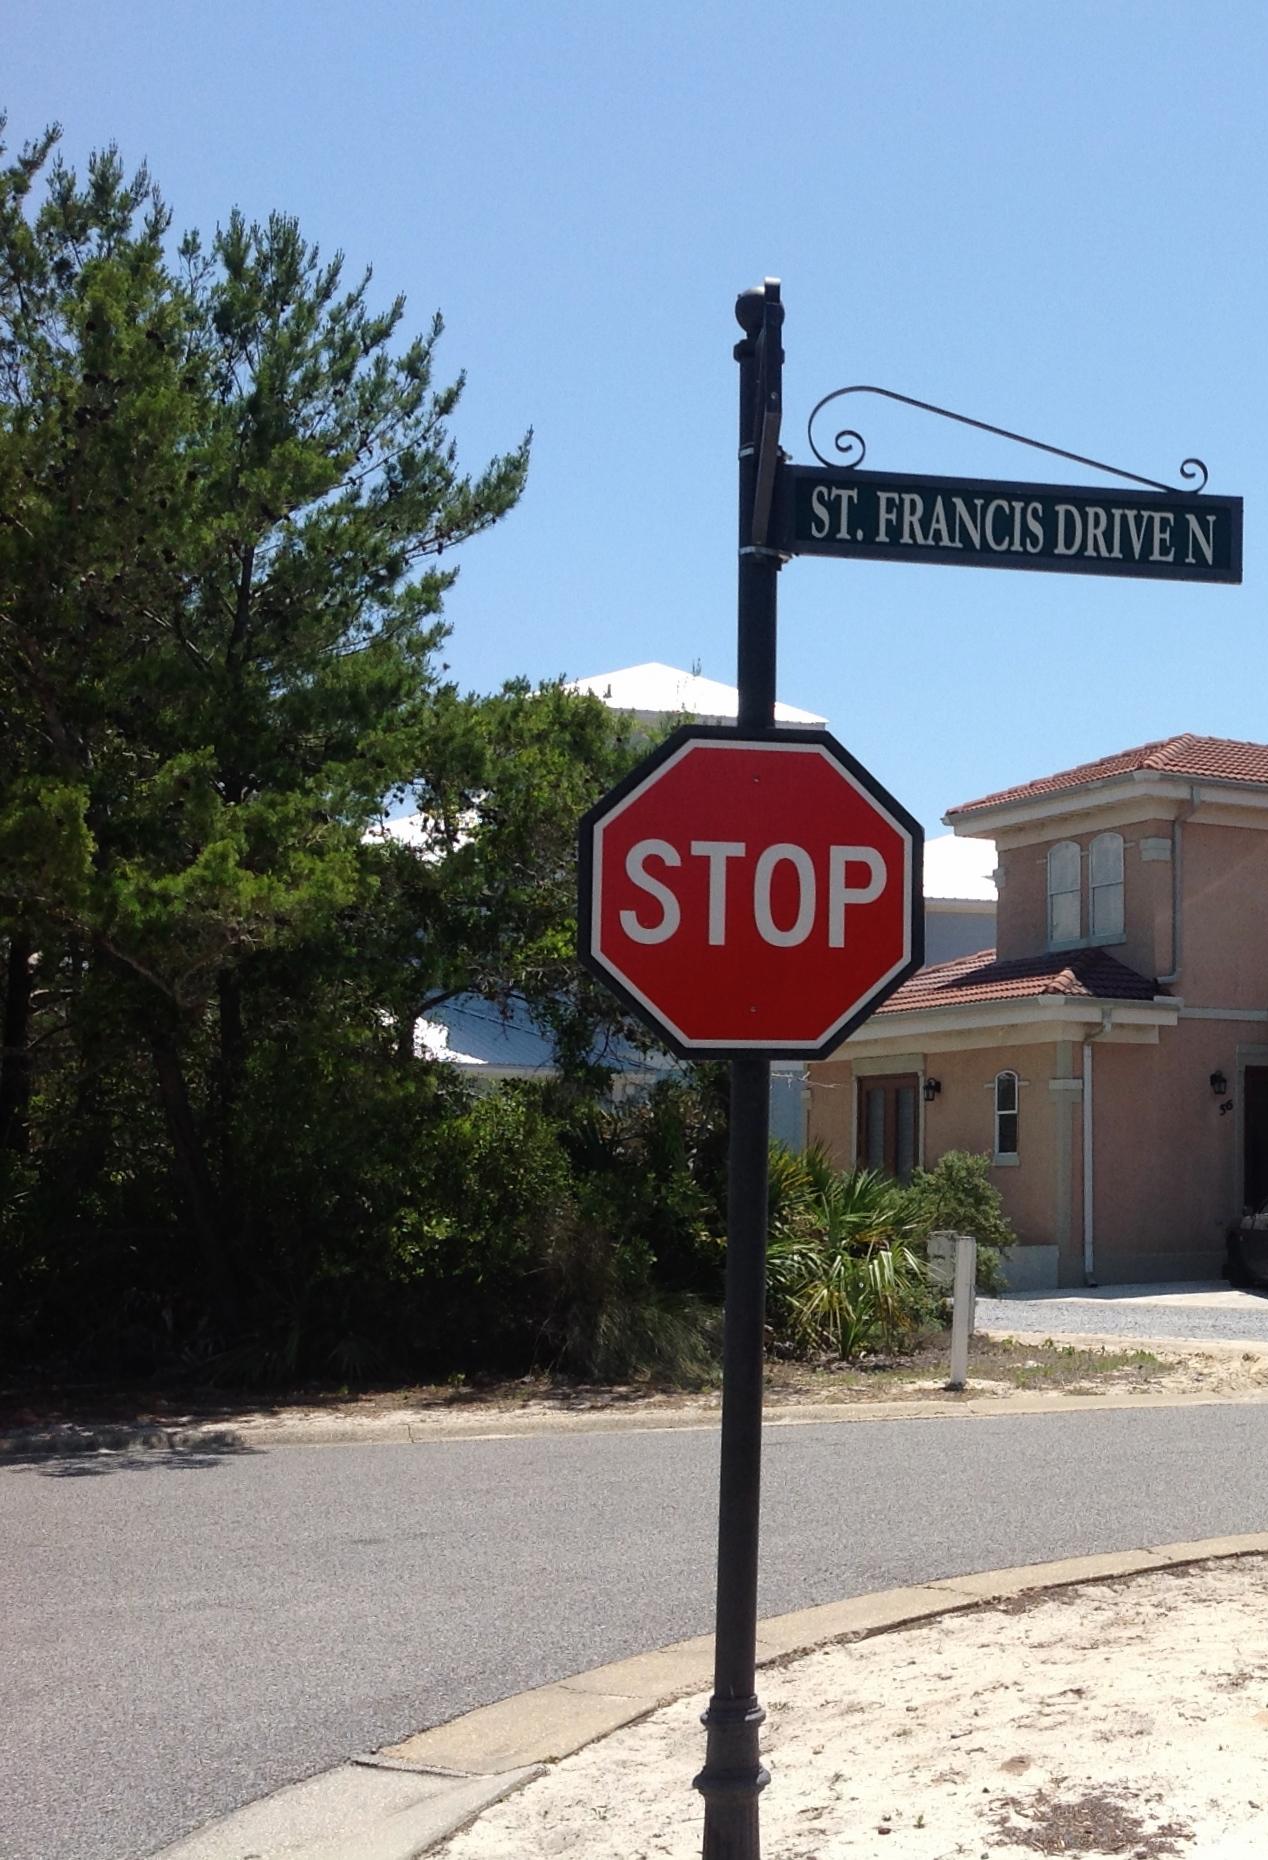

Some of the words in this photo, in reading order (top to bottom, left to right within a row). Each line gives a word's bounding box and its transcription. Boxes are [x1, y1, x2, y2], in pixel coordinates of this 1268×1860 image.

[811, 486, 864, 542] ST.
[876, 490, 1044, 553] FRANCIS
[1054, 504, 1175, 563] DRIVE
[1185, 513, 1217, 566] N
[619, 838, 888, 948] STOP
